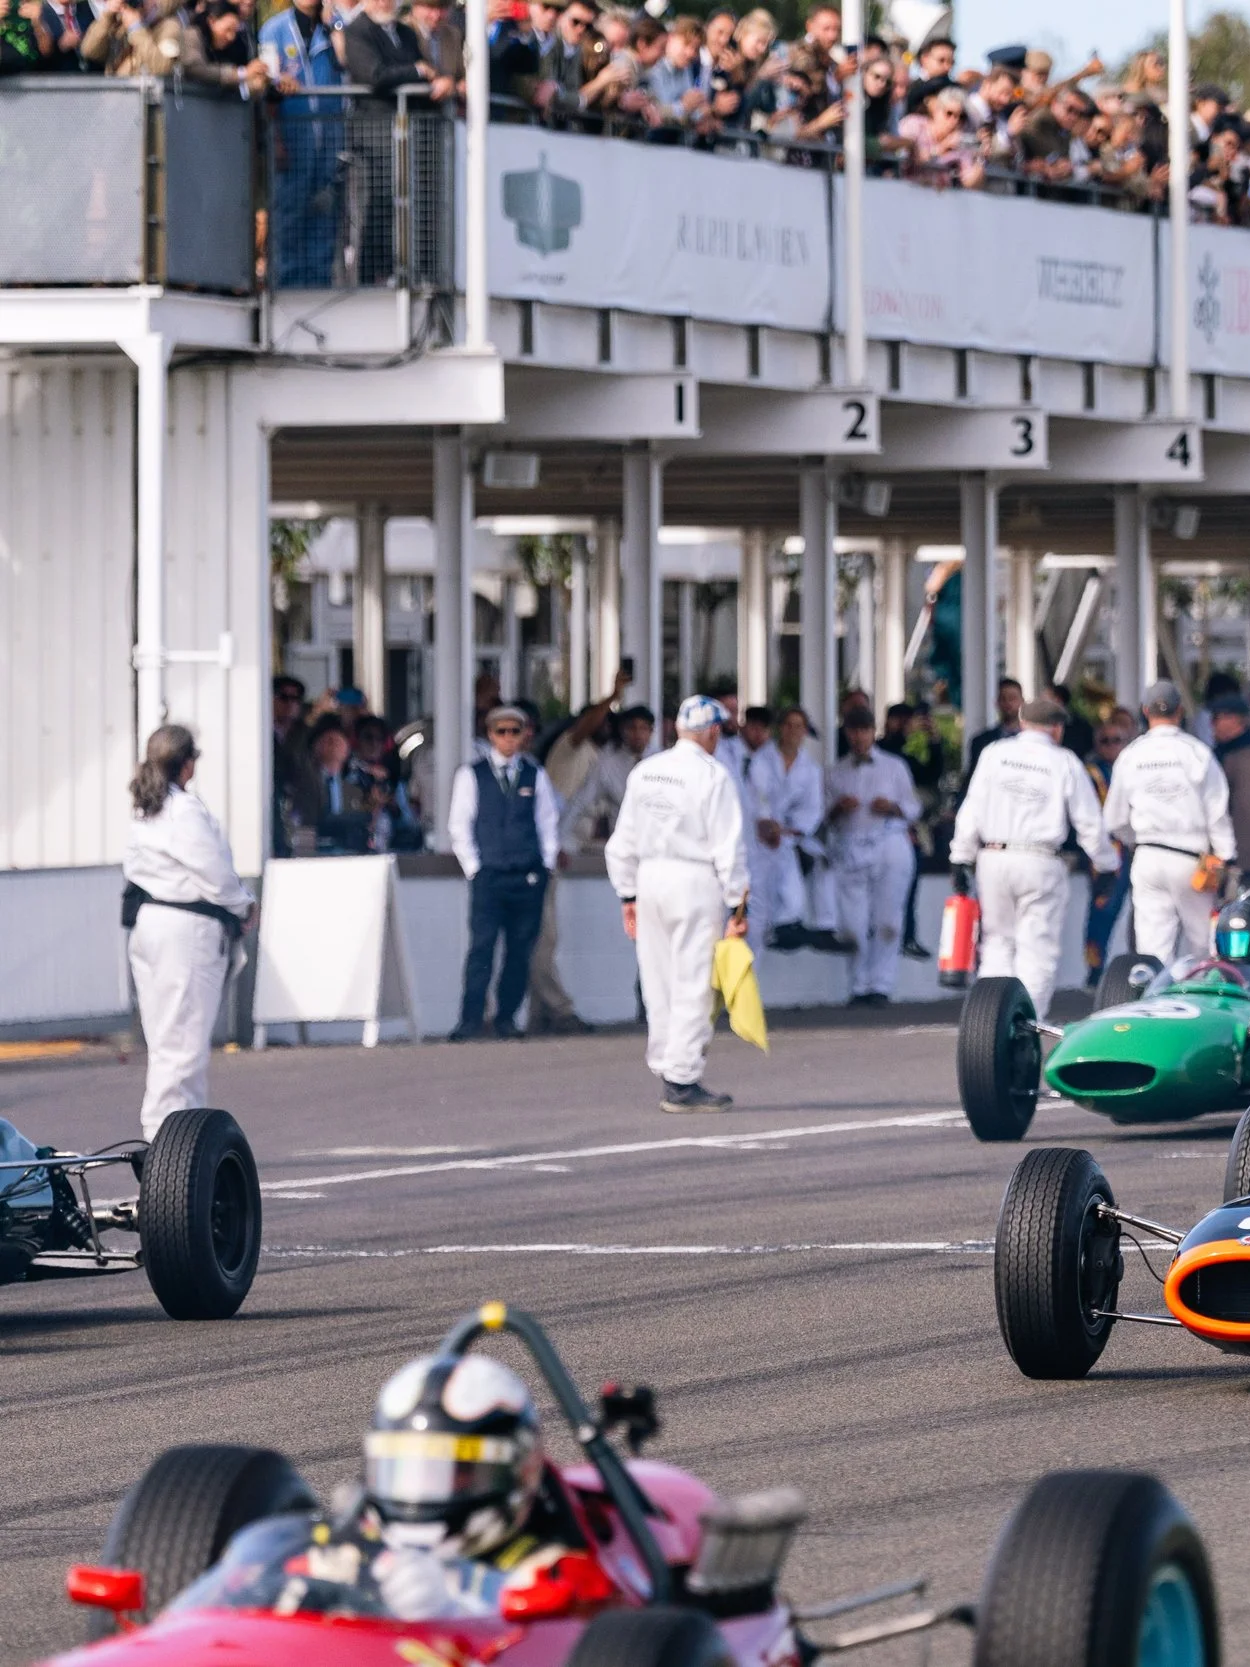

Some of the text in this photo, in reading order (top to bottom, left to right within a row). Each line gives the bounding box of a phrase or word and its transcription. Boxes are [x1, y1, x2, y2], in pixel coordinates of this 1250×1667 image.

[674, 382, 684, 424] 1
[842, 400, 868, 441] 2
[1011, 416, 1035, 456] 3
[1166, 431, 1191, 468] 4
